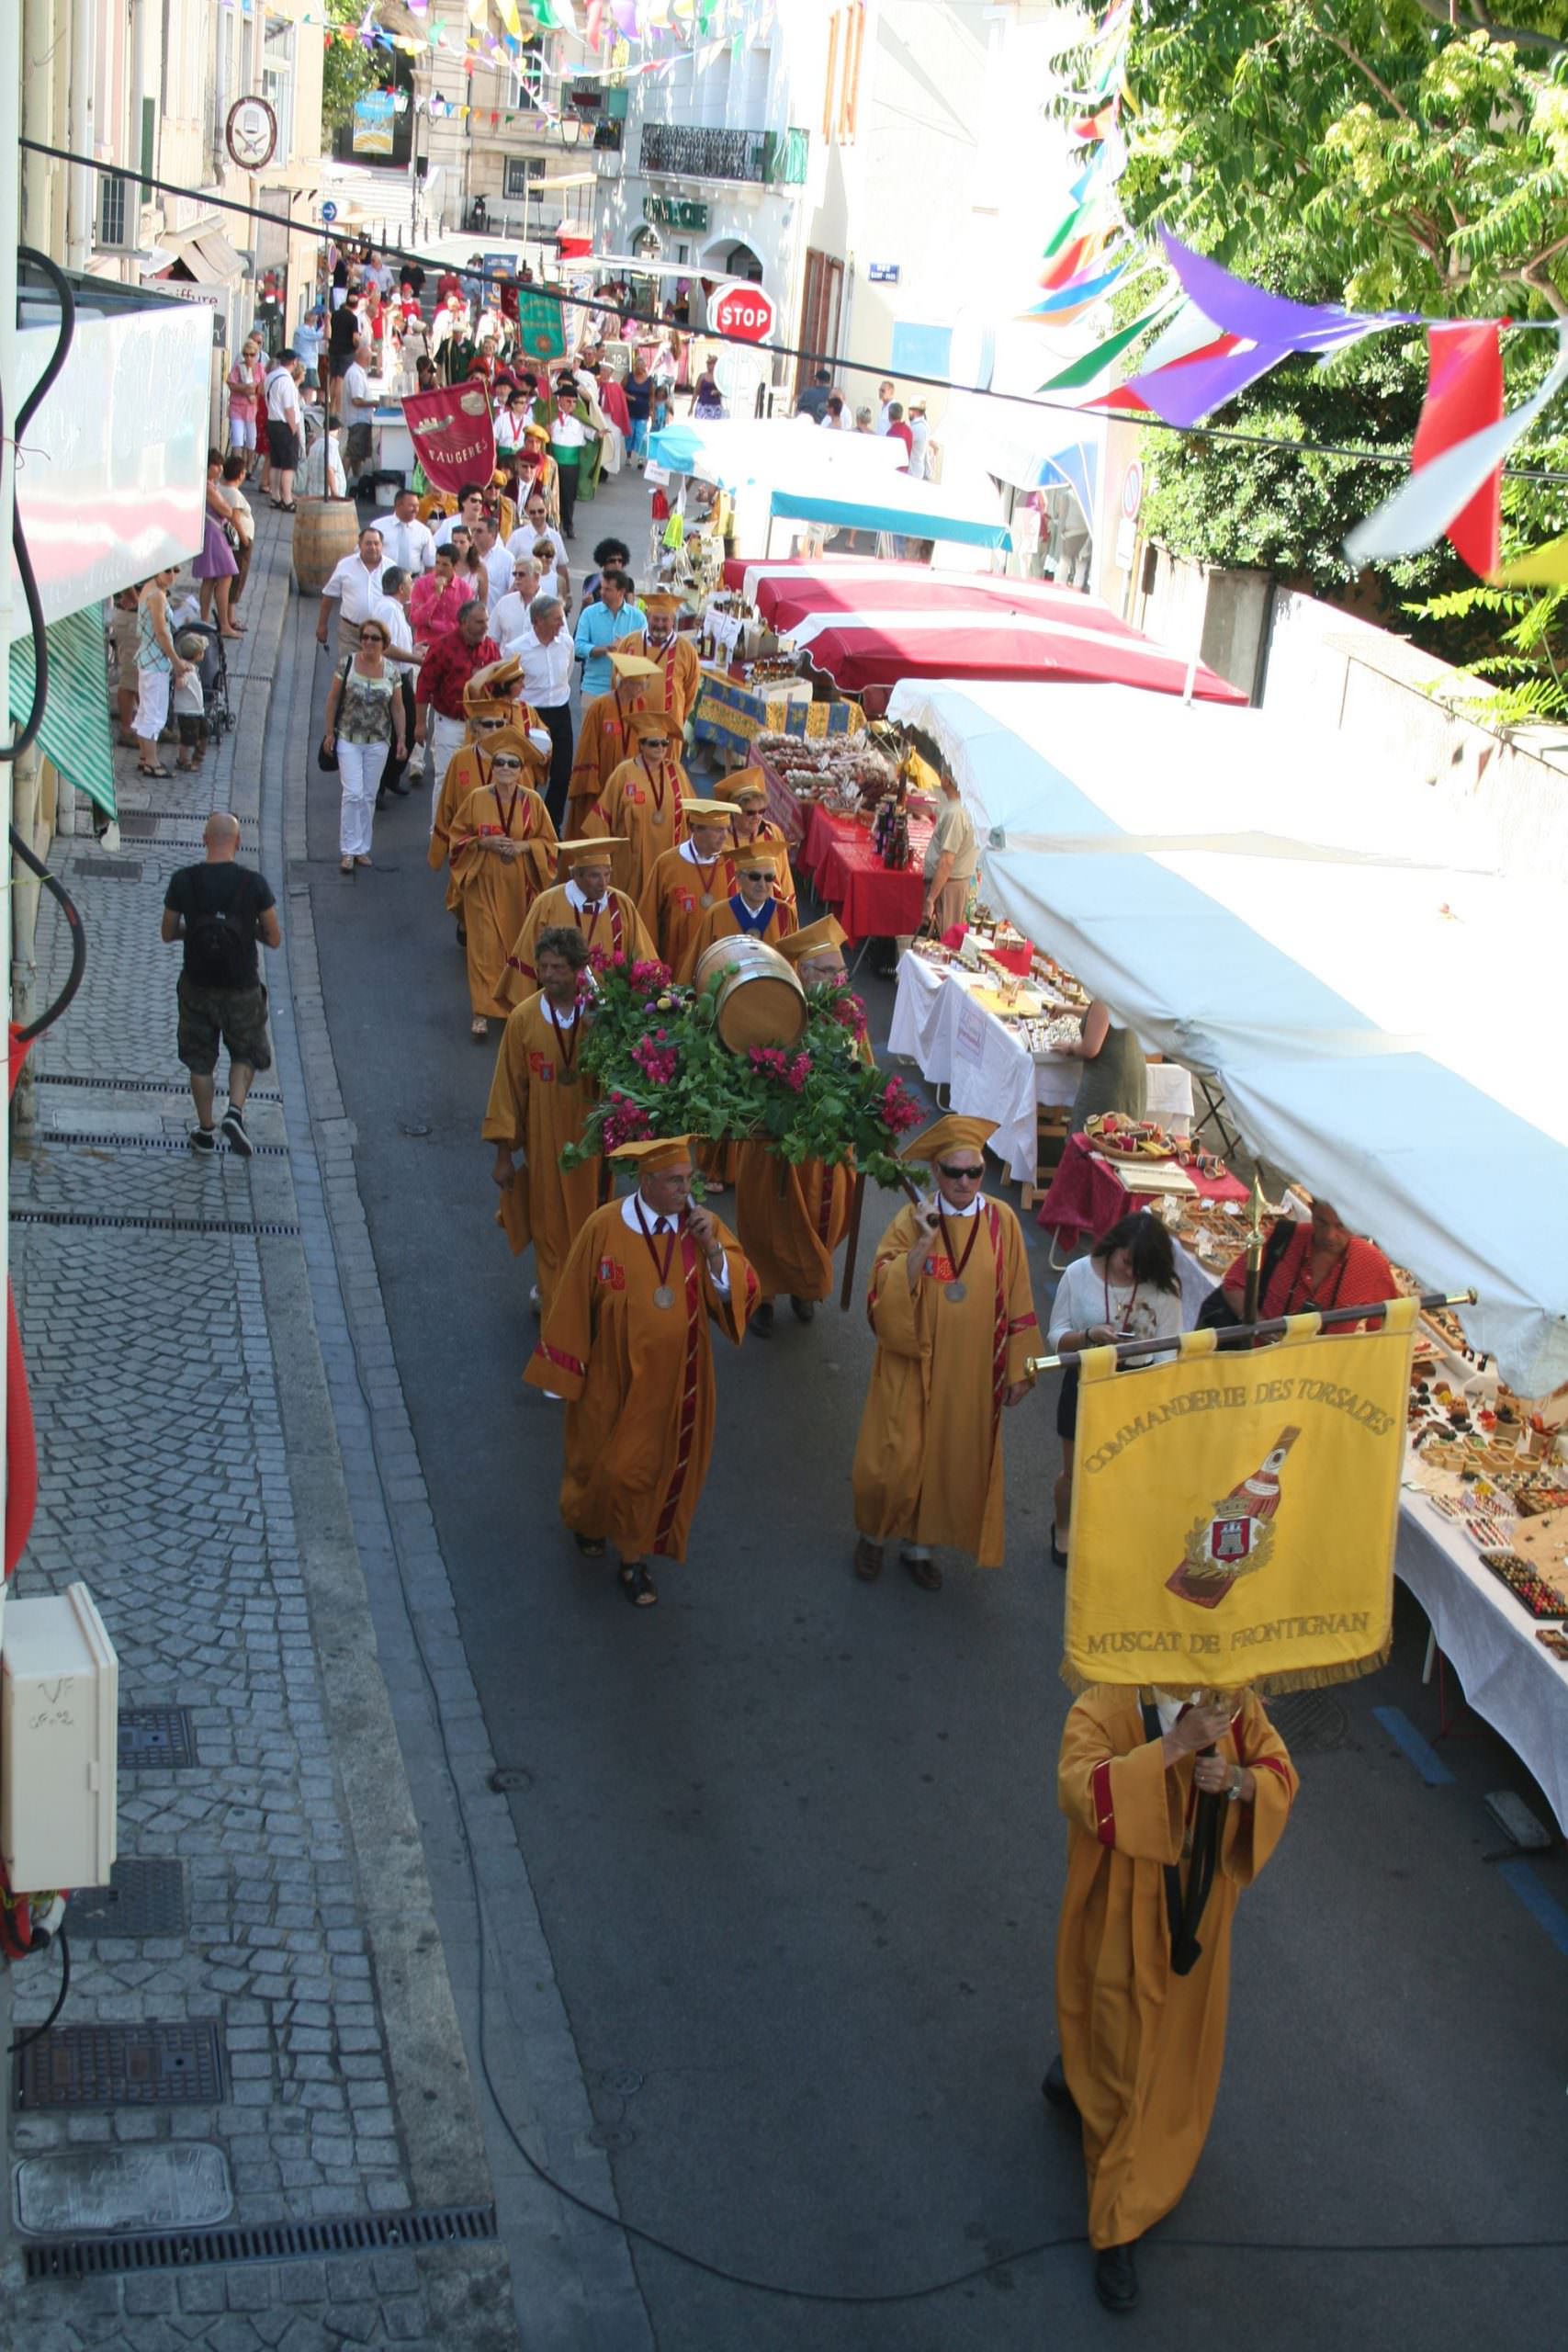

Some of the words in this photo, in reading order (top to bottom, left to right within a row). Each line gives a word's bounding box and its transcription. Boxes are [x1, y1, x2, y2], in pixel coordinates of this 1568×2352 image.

[156, 287, 219, 308] iffure
[721, 306, 768, 328] STOP
[1084, 1385, 1247, 1474] COMMANDERIE
[1254, 1378, 1294, 1405] DES
[1296, 1378, 1396, 1436] TORSADES
[1087, 1630, 1182, 1654] MUSCAT
[1189, 1633, 1221, 1654] DE
[1231, 1611, 1370, 1652] FRONTIGNAN
